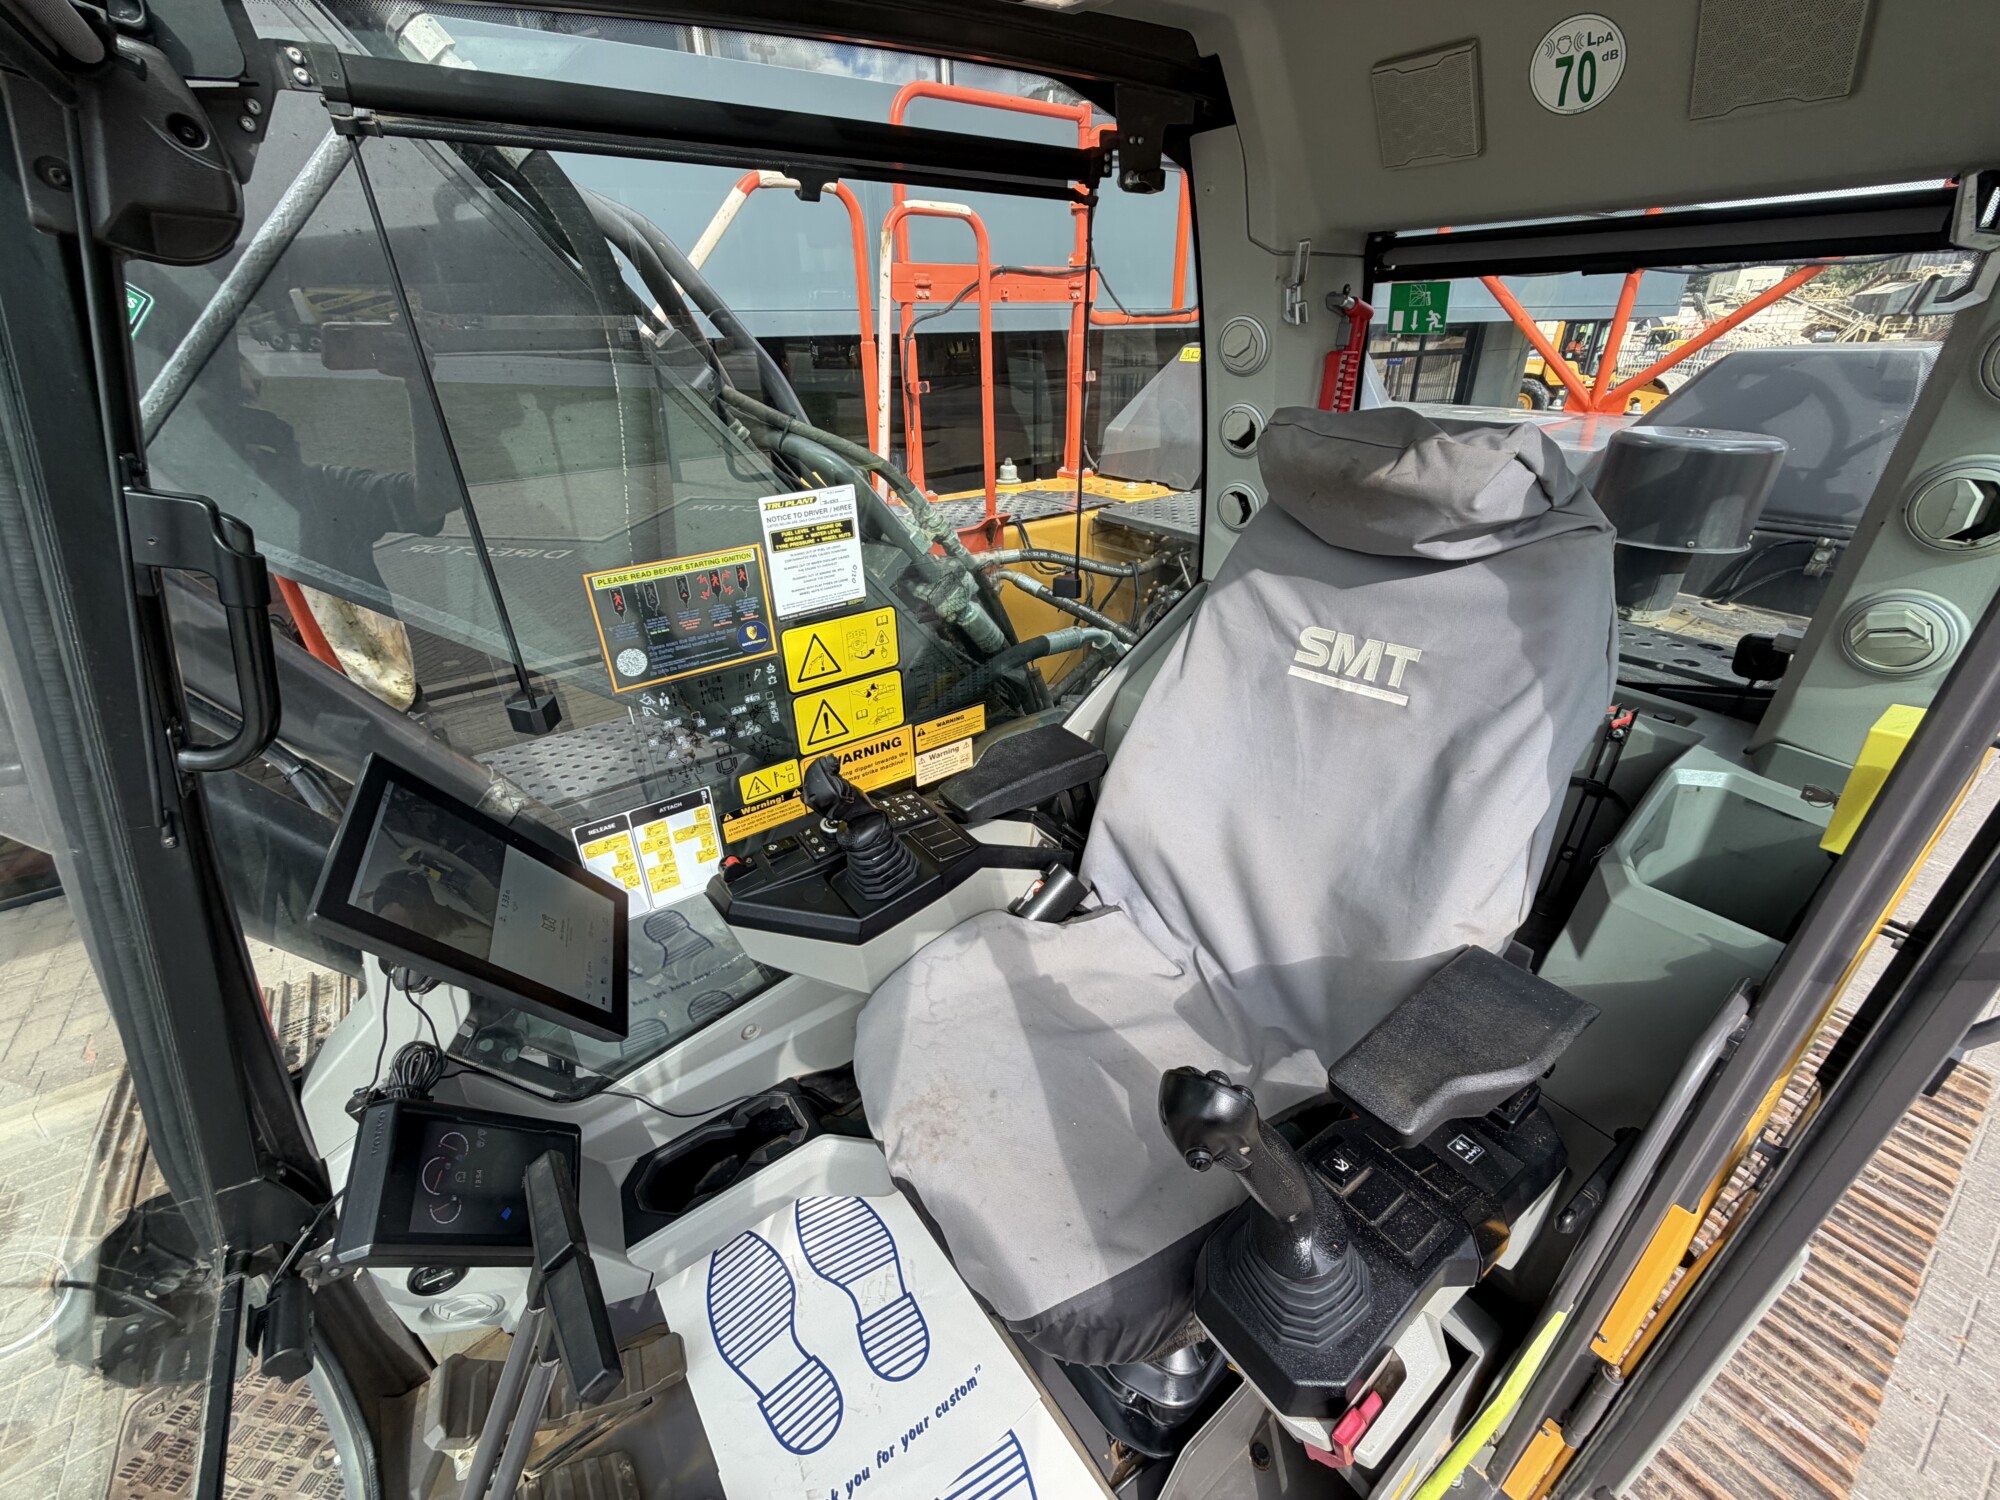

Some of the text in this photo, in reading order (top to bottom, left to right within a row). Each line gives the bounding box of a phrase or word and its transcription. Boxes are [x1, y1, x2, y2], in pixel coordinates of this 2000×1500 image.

[1587, 32, 1614, 47] LpA
[1556, 50, 1619, 107] 70 dB
[766, 501, 783, 510] TRU
[786, 497, 814, 507] PLANT
[766, 514, 791, 524] NOTICE
[804, 508, 828, 517] DRIVER
[834, 504, 852, 512] HIREE
[598, 553, 752, 586] PLEASE READ BEFORE STARTING IGNITION
[1294, 626, 1423, 689] SMT
[937, 715, 965, 728] WARNING
[929, 746, 960, 761] Warning
[849, 773, 861, 781] may
[862, 768, 879, 778] strike
[880, 759, 906, 770] machine!
[855, 763, 874, 773] dipper
[875, 756, 898, 766] inwards
[659, 802, 683, 813] ATTACH
[741, 795, 785, 815] Warning!
[588, 823, 616, 836] RELEASE
[370, 1110, 386, 1157] VOLVO
[846, 1466, 870, 1500] you
[877, 1445, 896, 1469] for
[901, 1416, 930, 1452] your
